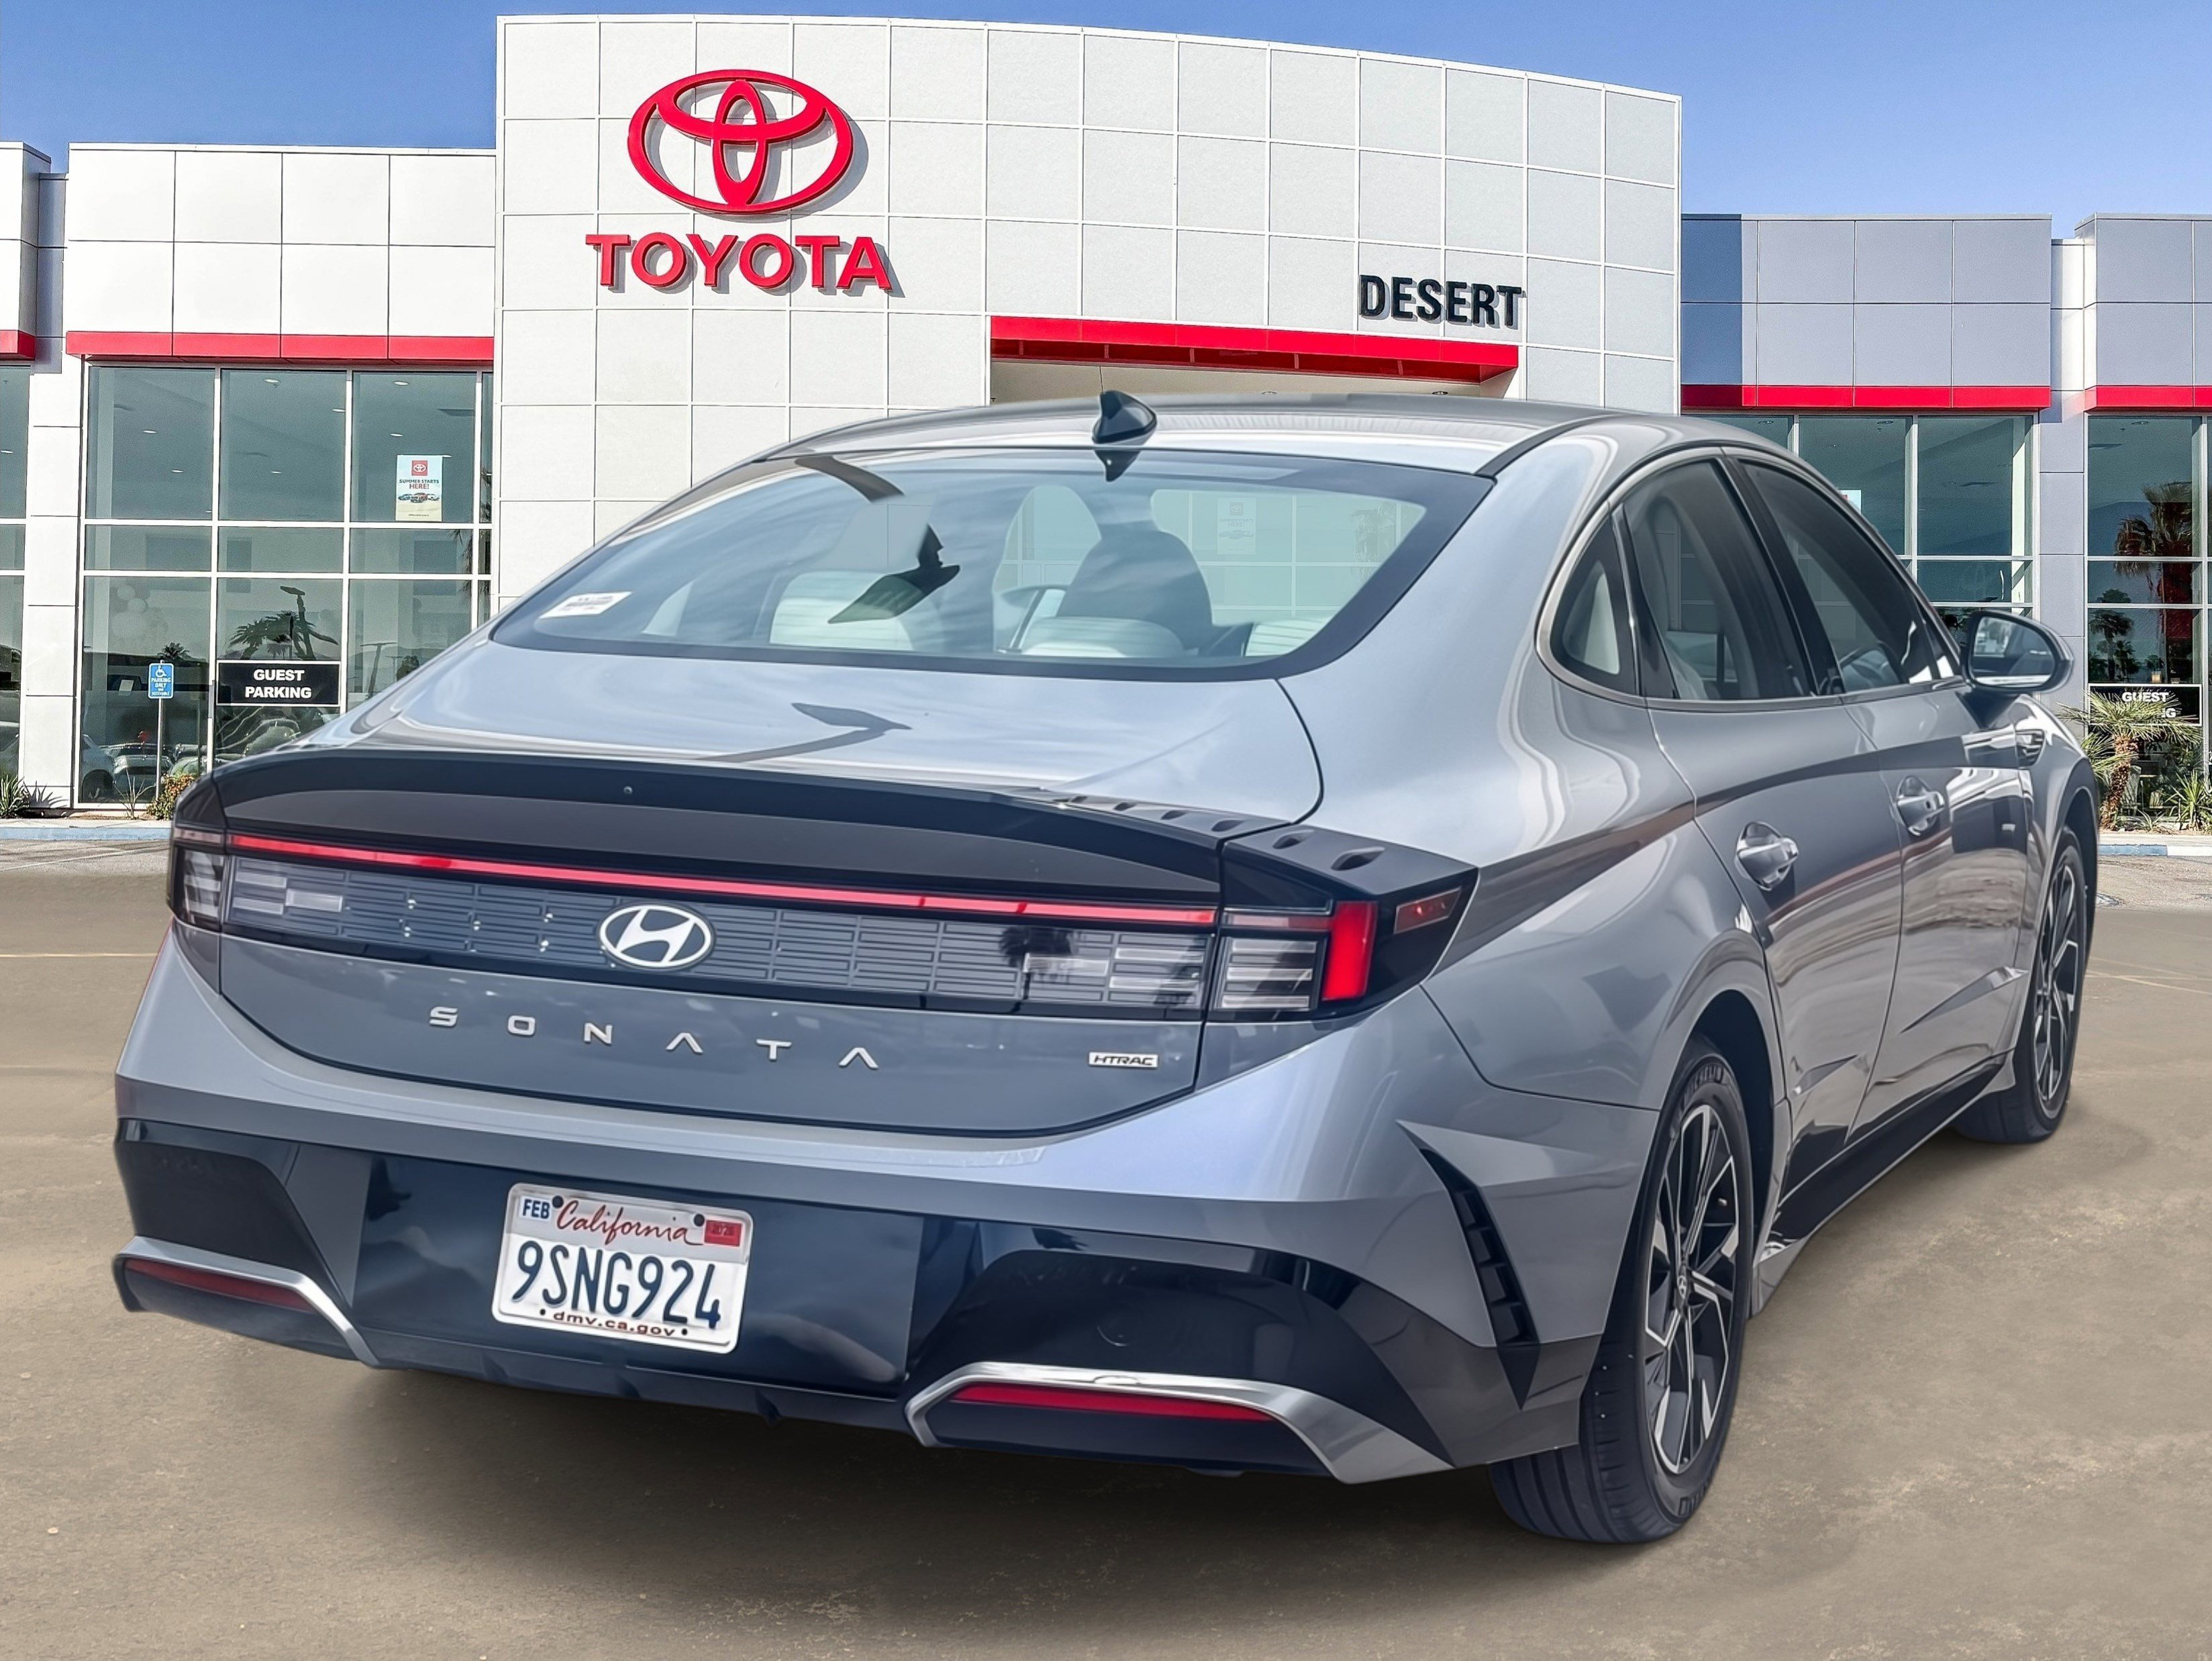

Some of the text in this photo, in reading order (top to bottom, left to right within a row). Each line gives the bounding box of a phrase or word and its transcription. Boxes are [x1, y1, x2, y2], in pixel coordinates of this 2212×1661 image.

[585, 232, 893, 290] TOYOTA
[1358, 274, 1522, 327] DESERT
[244, 686, 312, 699] PARKING
[253, 668, 305, 681] GUEST
[2121, 691, 2169, 703] GUEST
[429, 1005, 879, 1070] SONATA
[1093, 1055, 1154, 1066] HTRAC
[521, 1198, 704, 1246] FEB California
[512, 1240, 721, 1329] 9SNG924
[553, 1311, 677, 1338] dmv.ca.gov
